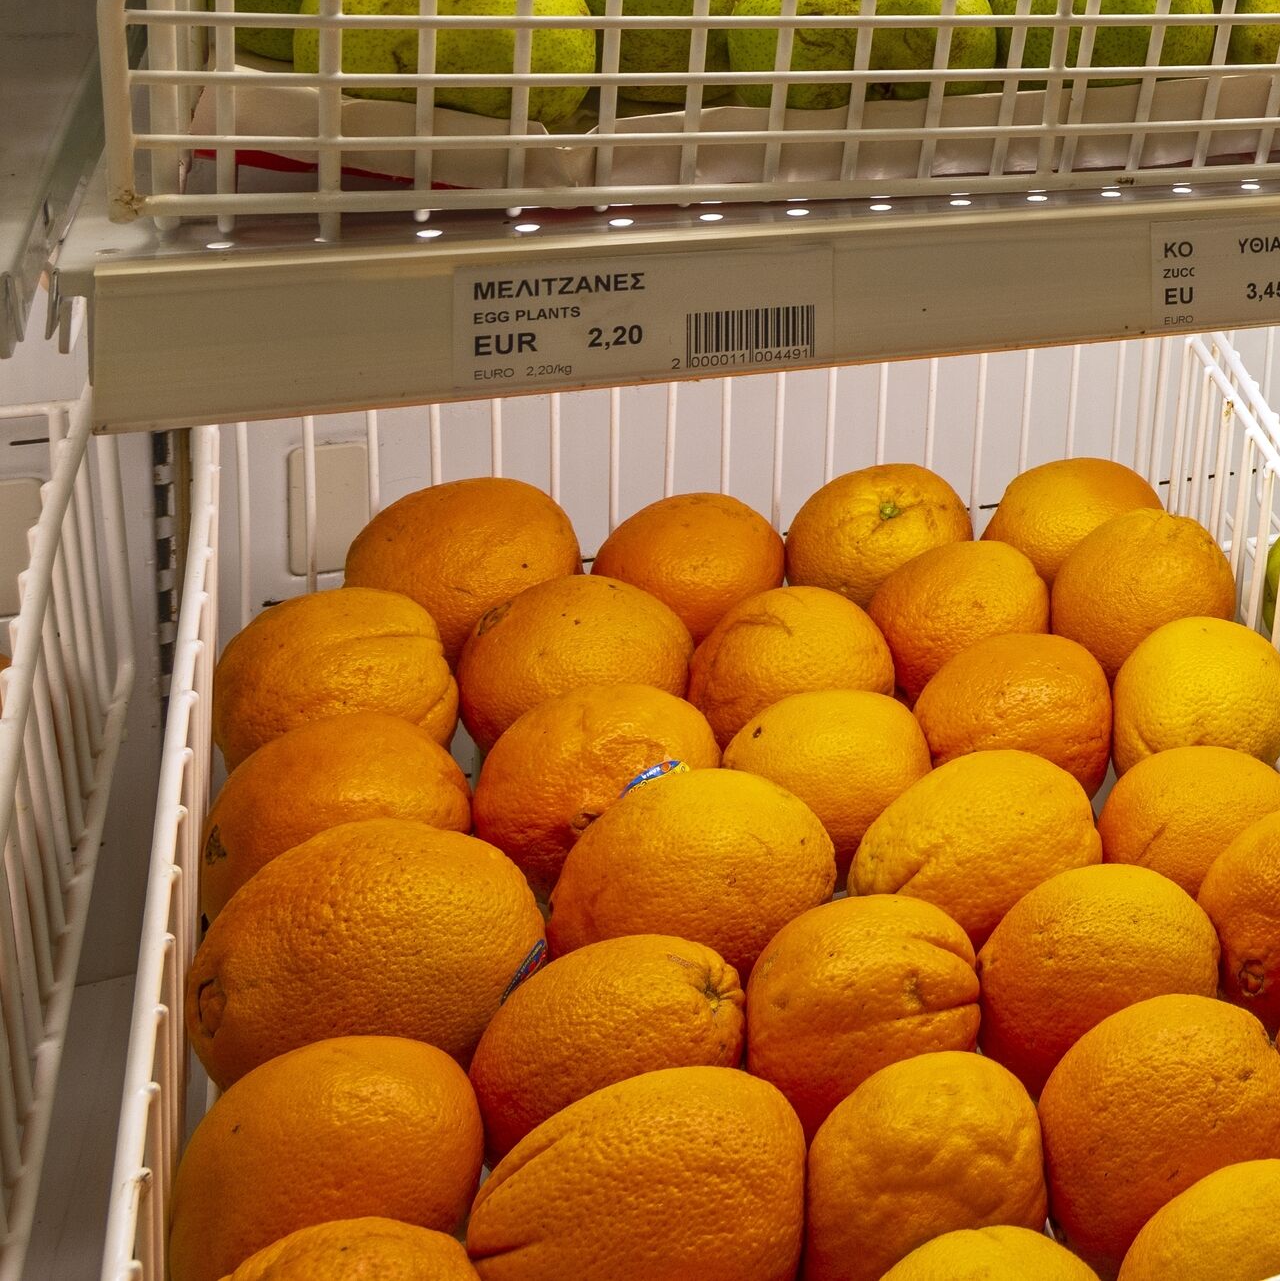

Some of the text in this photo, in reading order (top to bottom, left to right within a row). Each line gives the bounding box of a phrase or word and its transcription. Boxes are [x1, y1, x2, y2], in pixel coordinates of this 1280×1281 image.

[473, 272, 645, 301] ΜΕΛΙΤΖΑΝΕΣ
[473, 305, 581, 325] EGG PLANTS
[1164, 315, 1193, 325] EURO
[474, 324, 644, 356] EUR 2,20
[474, 363, 573, 380] EURO 2,20/kg
